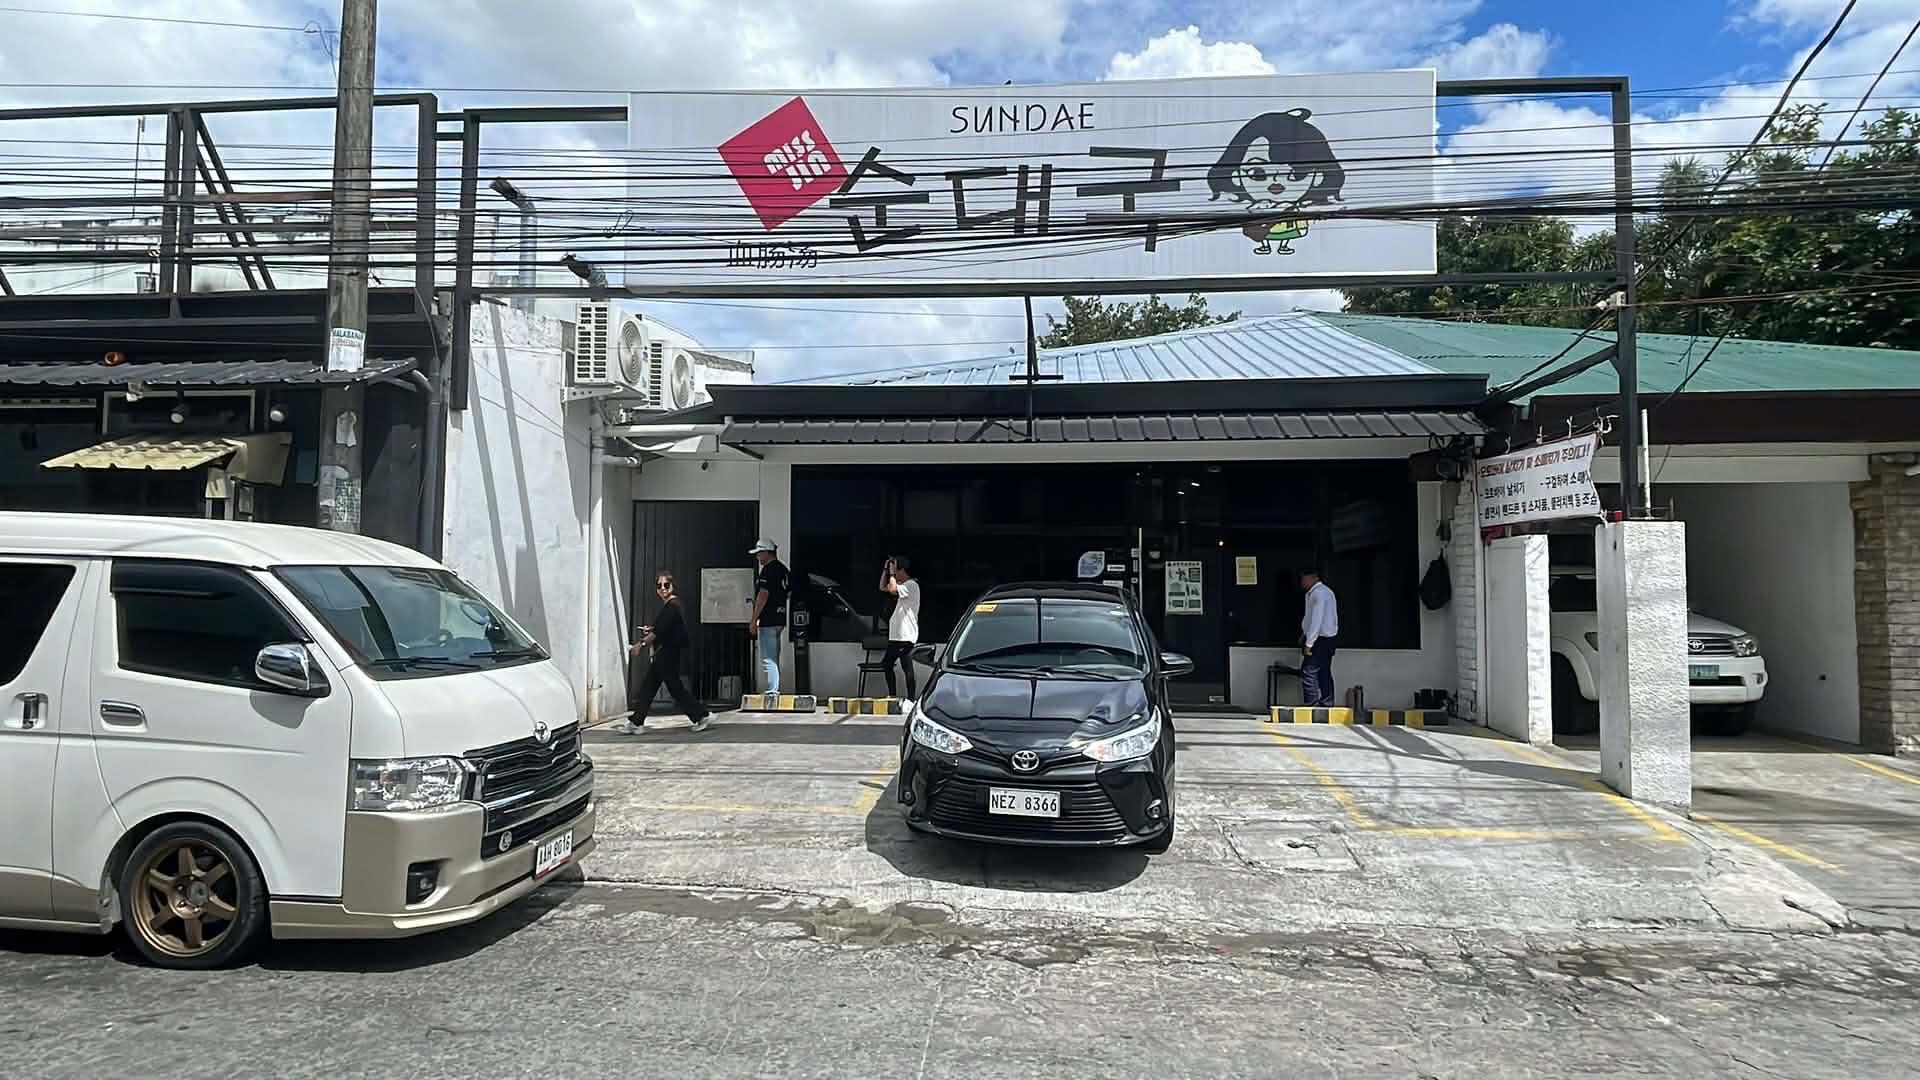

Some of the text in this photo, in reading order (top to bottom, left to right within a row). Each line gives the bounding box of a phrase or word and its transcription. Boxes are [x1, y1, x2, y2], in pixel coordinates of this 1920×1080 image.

[950, 102, 1095, 134] SUNDAE
[991, 794, 1057, 812] NEZ 8366
